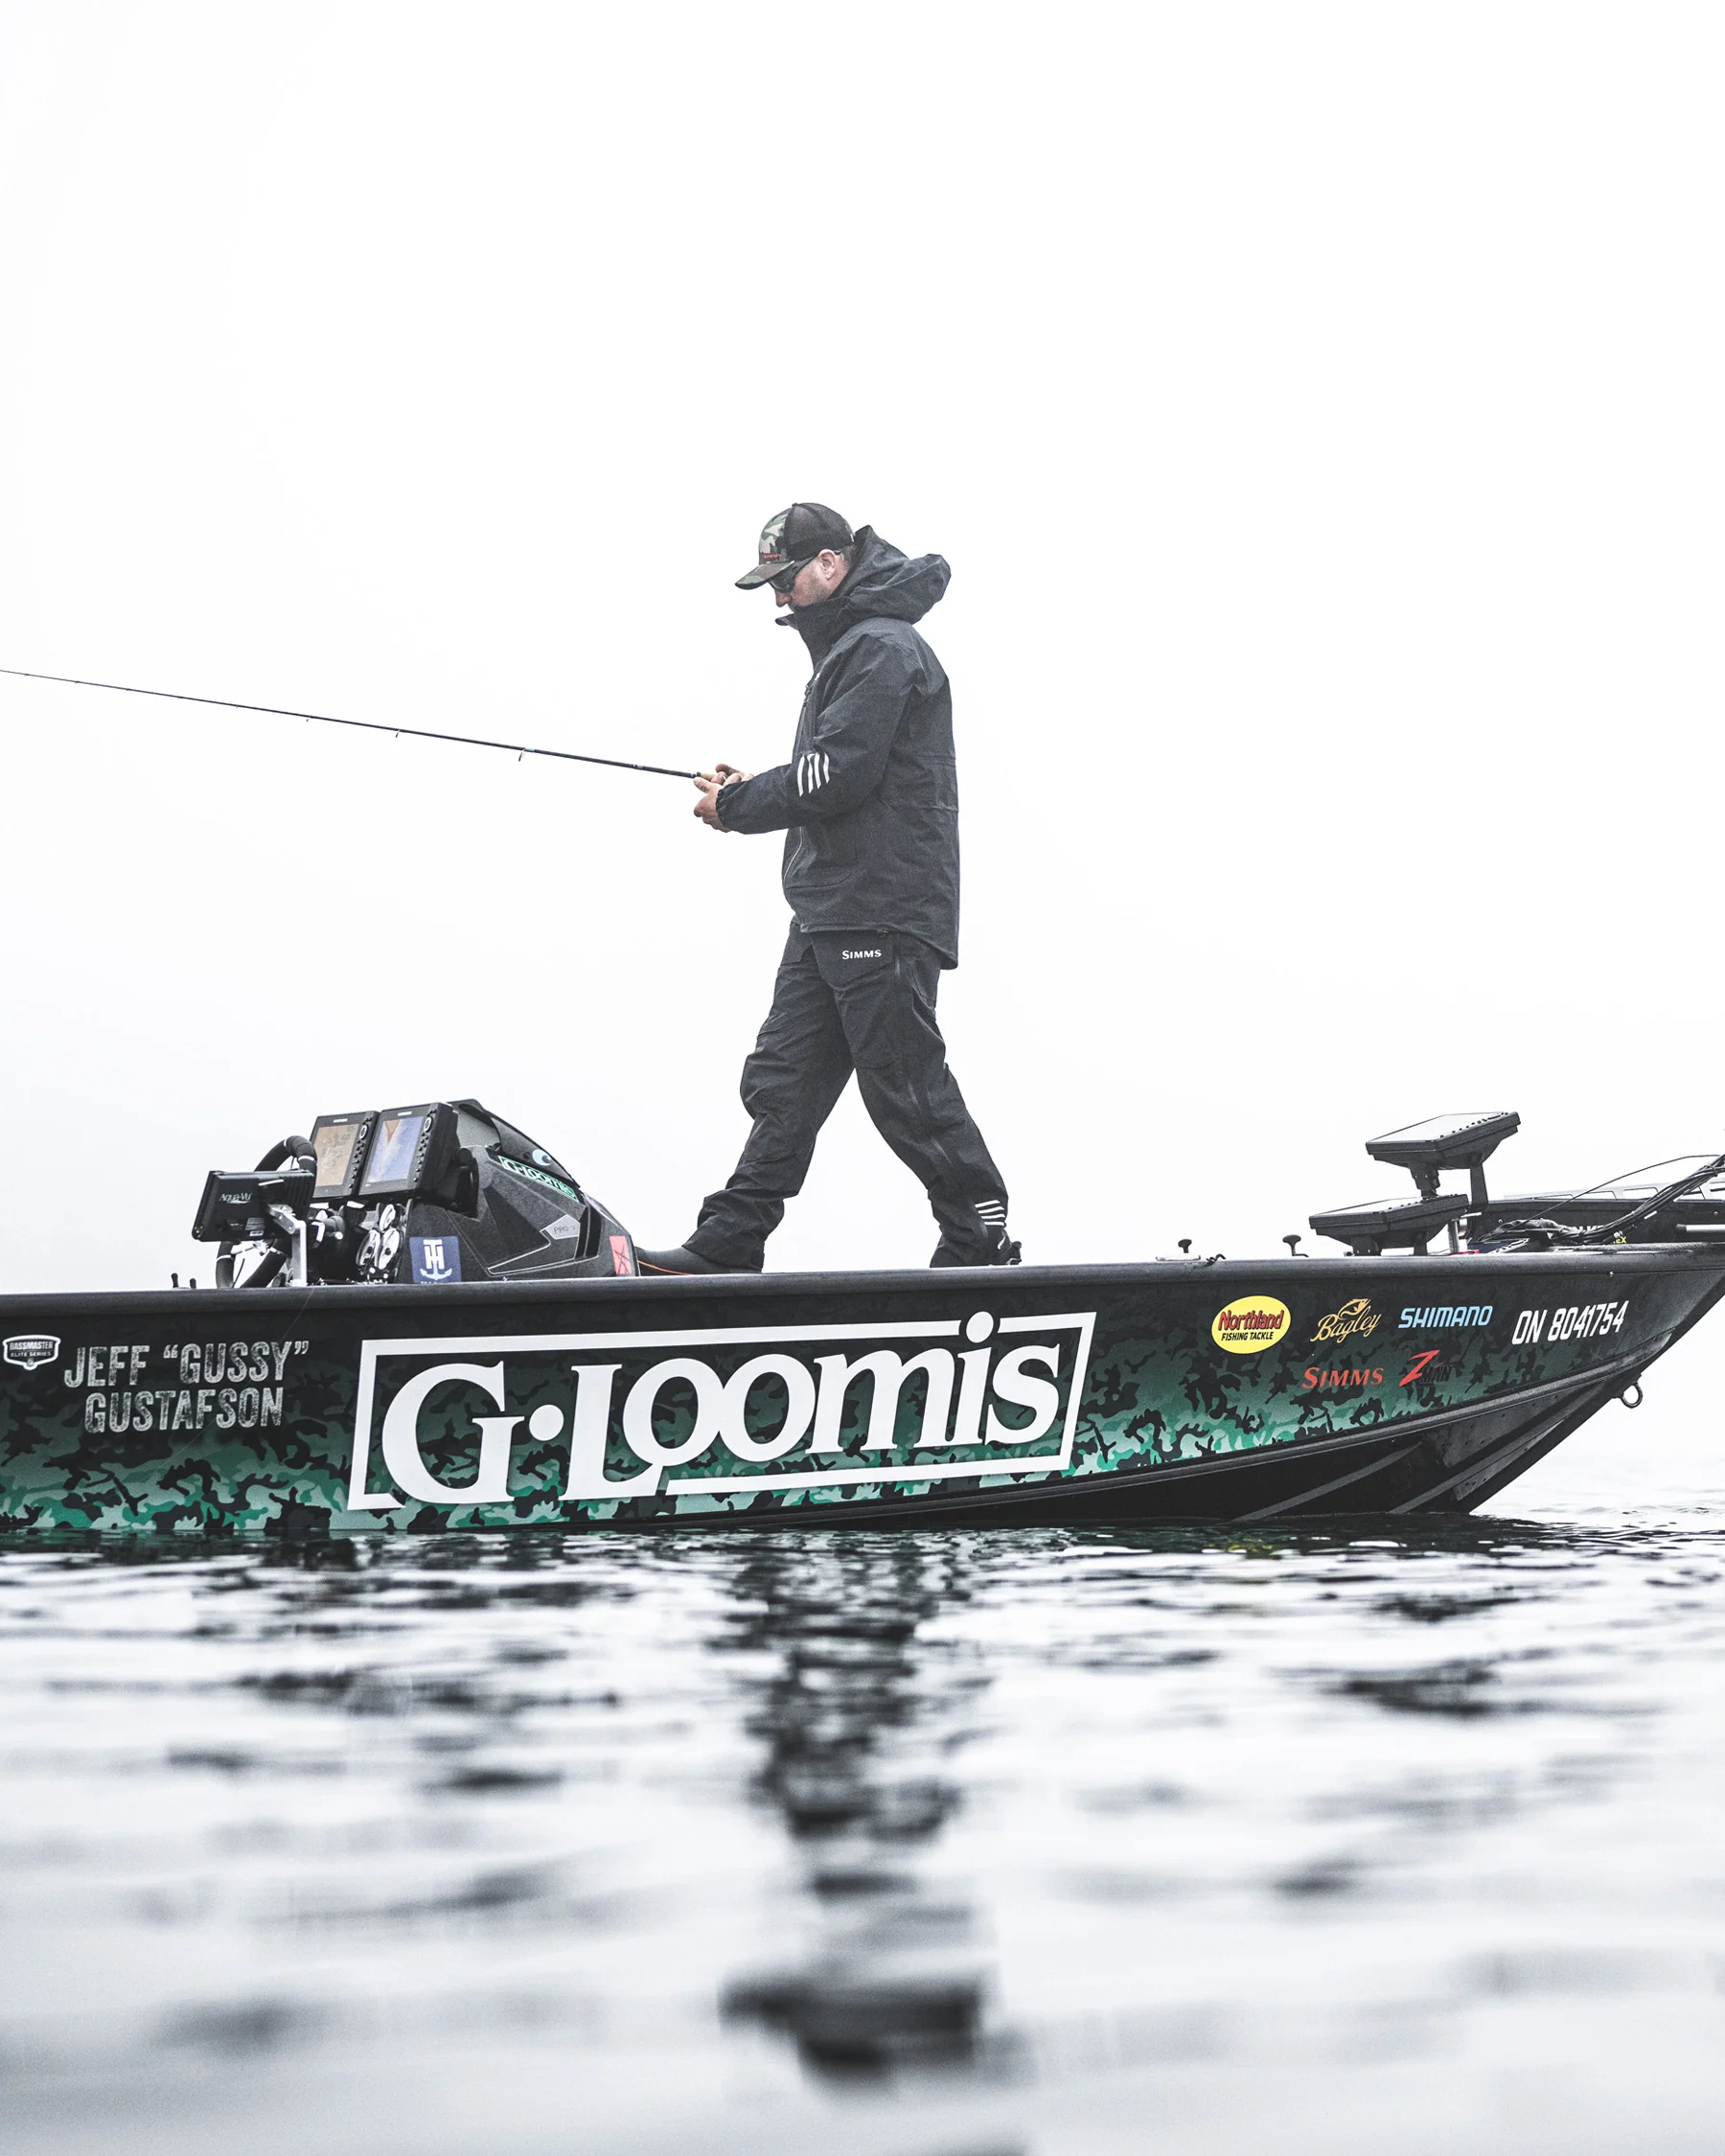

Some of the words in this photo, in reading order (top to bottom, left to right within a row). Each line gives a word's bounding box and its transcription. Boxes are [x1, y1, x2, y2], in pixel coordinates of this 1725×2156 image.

[841, 949, 882, 960] SIMMS
[1217, 1309, 1285, 1332] Northland
[1309, 1304, 1383, 1343] Bagley
[1397, 1305, 1494, 1329] SHIMANO
[1511, 1309, 1548, 1345] ON
[1547, 1300, 1630, 1342] 8041754
[1221, 1332, 1249, 1342] FISHING
[1249, 1330, 1275, 1341] TACKLE
[64, 1344, 150, 1388] JEFF
[1301, 1365, 1386, 1389] SIMMS
[84, 1387, 285, 1434] GUSTAFSON
